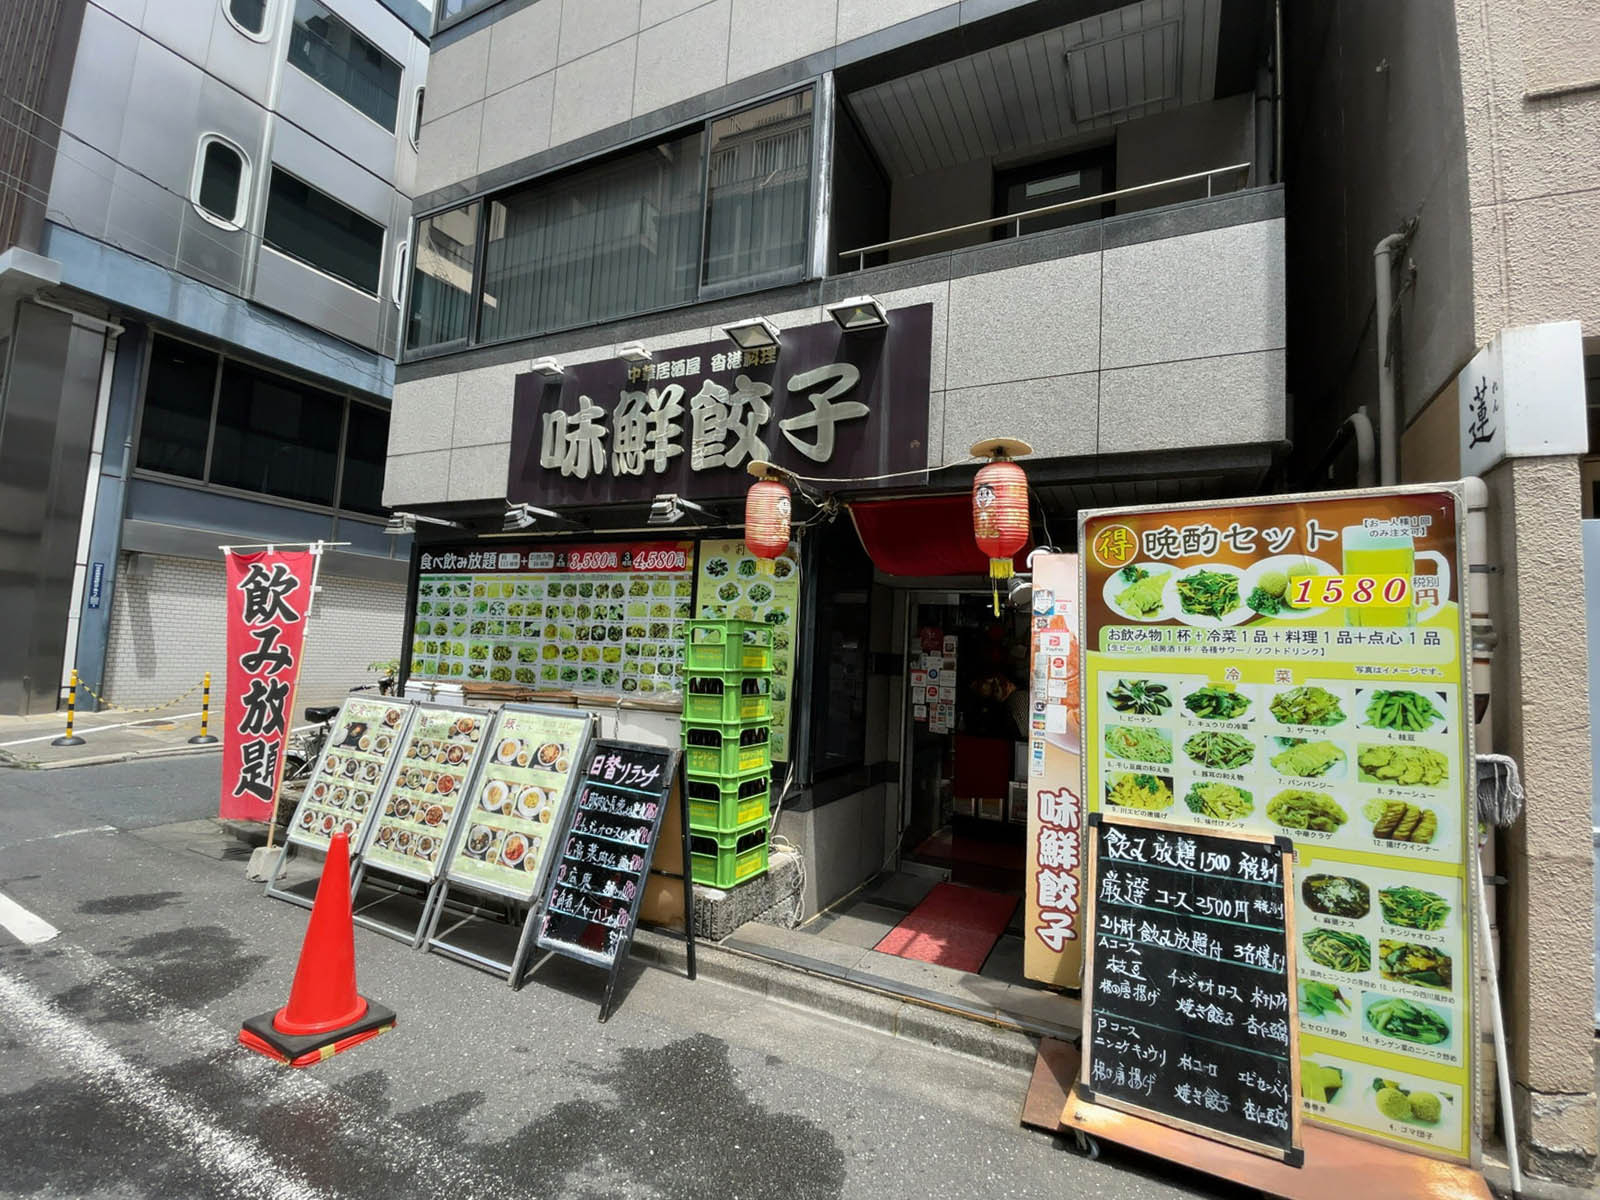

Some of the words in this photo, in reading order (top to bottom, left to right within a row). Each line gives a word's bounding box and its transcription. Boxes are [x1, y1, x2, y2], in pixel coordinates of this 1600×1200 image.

[628, 357, 700, 383] 中華居酒屋
[711, 346, 777, 372] 香港料理
[540, 363, 870, 478] 味鮮餃子
[1097, 528, 1133, 560] 得
[1144, 520, 1337, 558] 晩酌セット
[420, 552, 497, 570] 食べ飲み放題
[1294, 578, 1406, 603] 1580
[1412, 576, 1439, 588] 税別
[1415, 588, 1440, 606] 円
[233, 563, 300, 802] 飲み放題
[1036, 788, 1080, 952] 味鮮餃子
[1200, 851, 1231, 872] 1500
